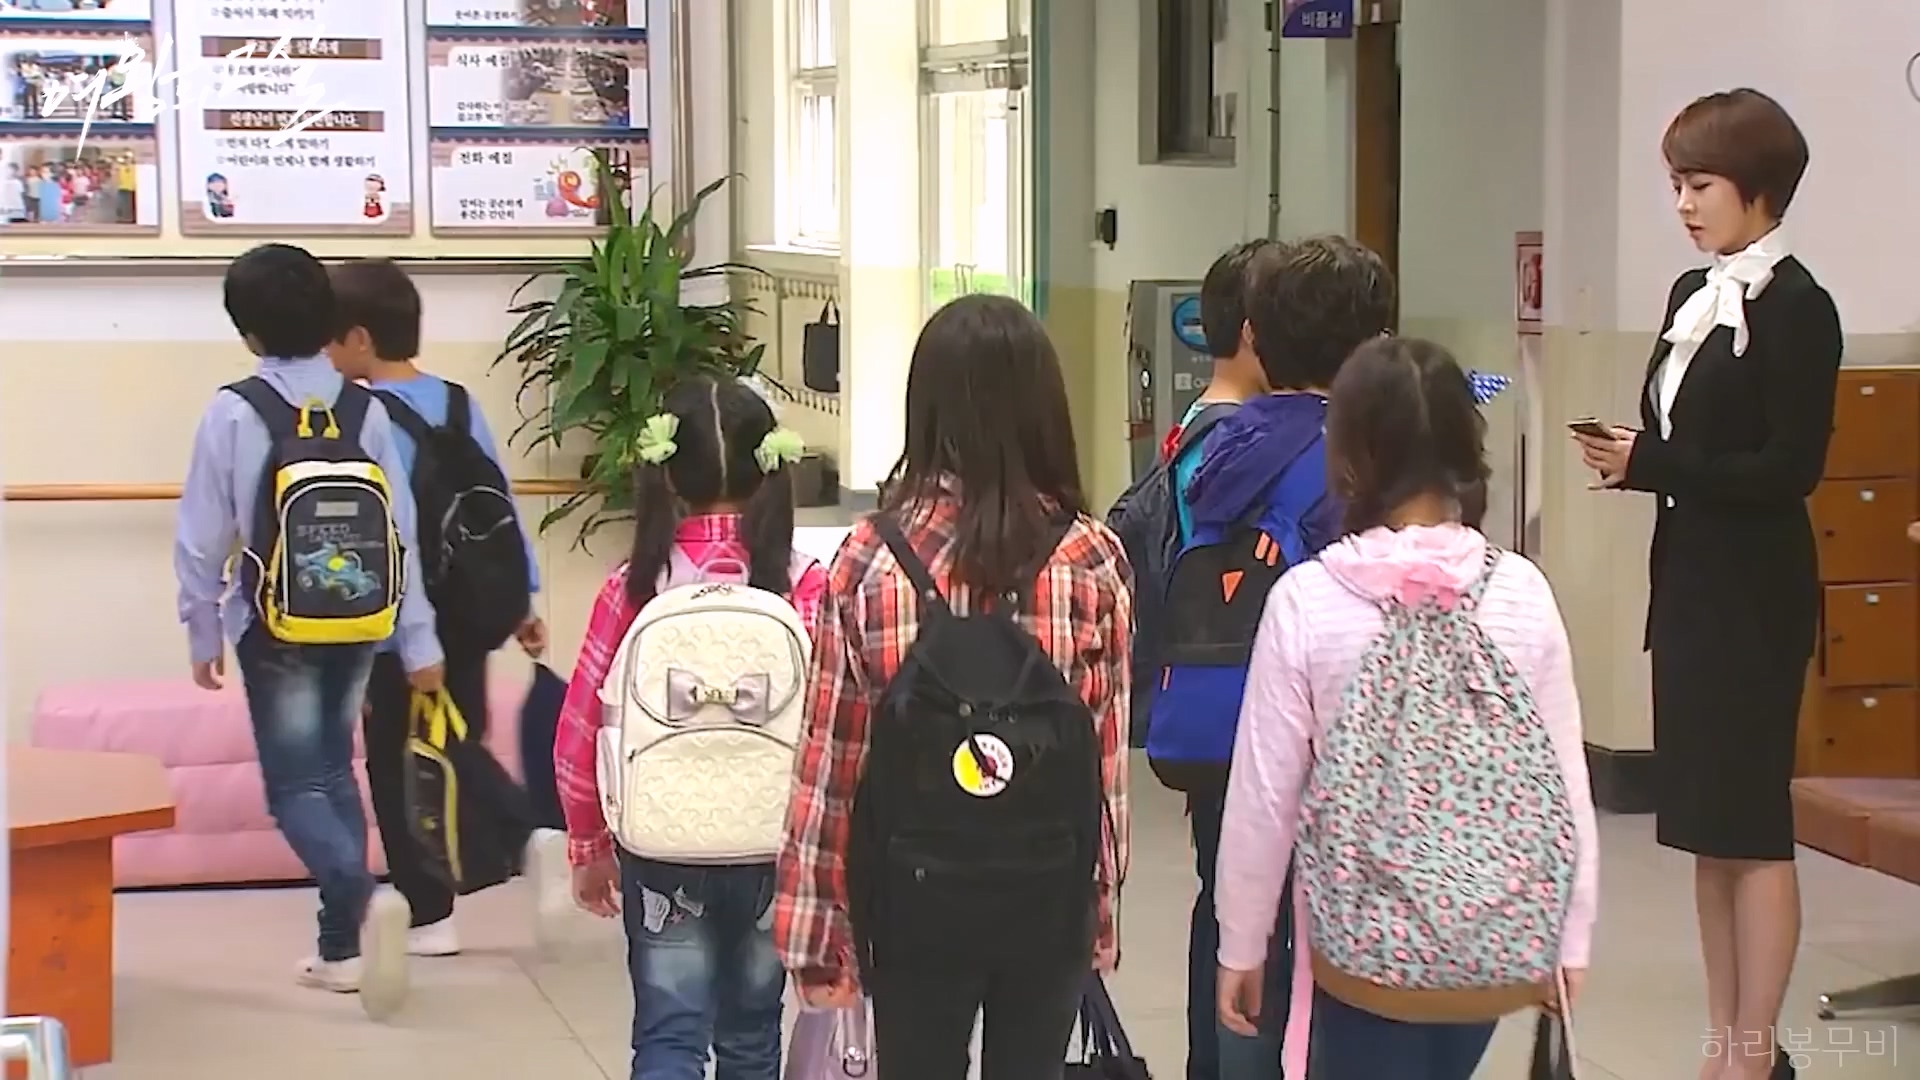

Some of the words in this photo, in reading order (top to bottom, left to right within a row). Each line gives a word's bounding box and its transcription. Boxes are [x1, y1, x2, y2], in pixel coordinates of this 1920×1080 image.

[1302, 11, 1343, 28] 비품실
[456, 53, 481, 68] 식사
[460, 151, 483, 165] 전화
[487, 151, 513, 165] 예절
